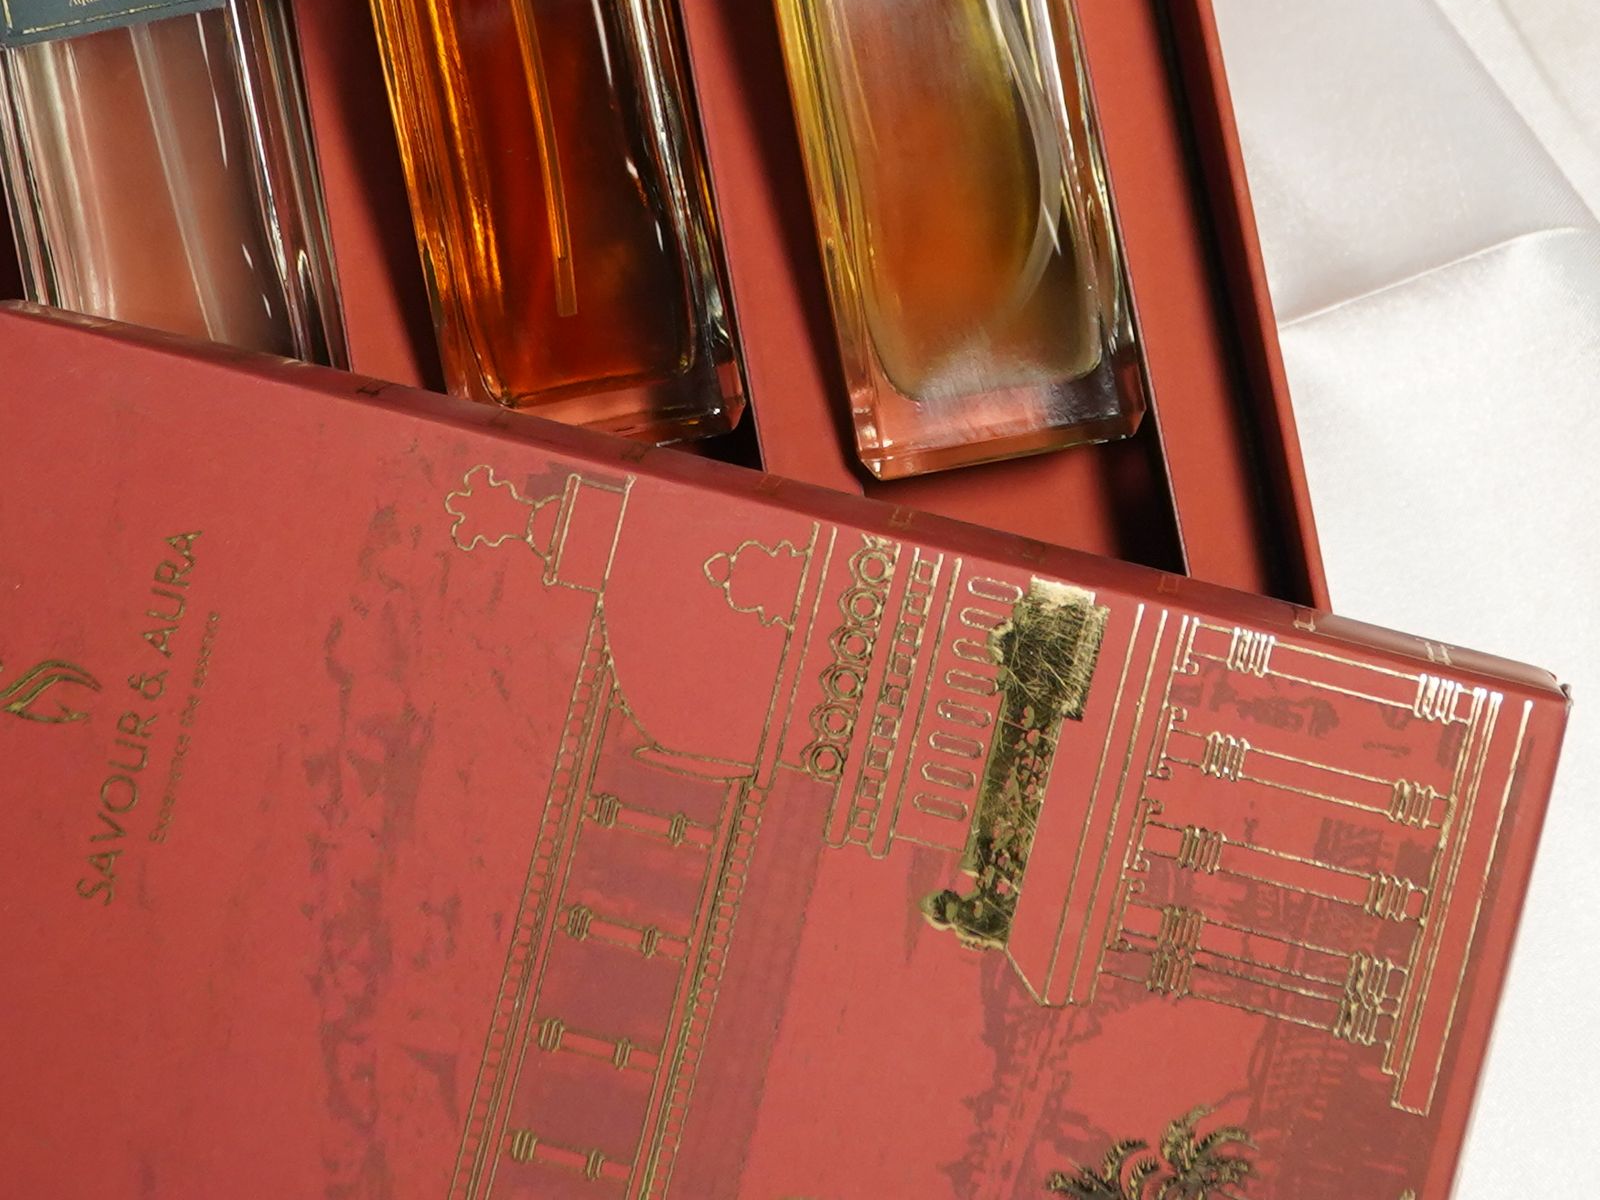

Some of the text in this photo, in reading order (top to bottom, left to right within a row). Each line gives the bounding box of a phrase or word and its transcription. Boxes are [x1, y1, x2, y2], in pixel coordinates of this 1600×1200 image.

[75, 529, 203, 906] SAVOUR & AURA
